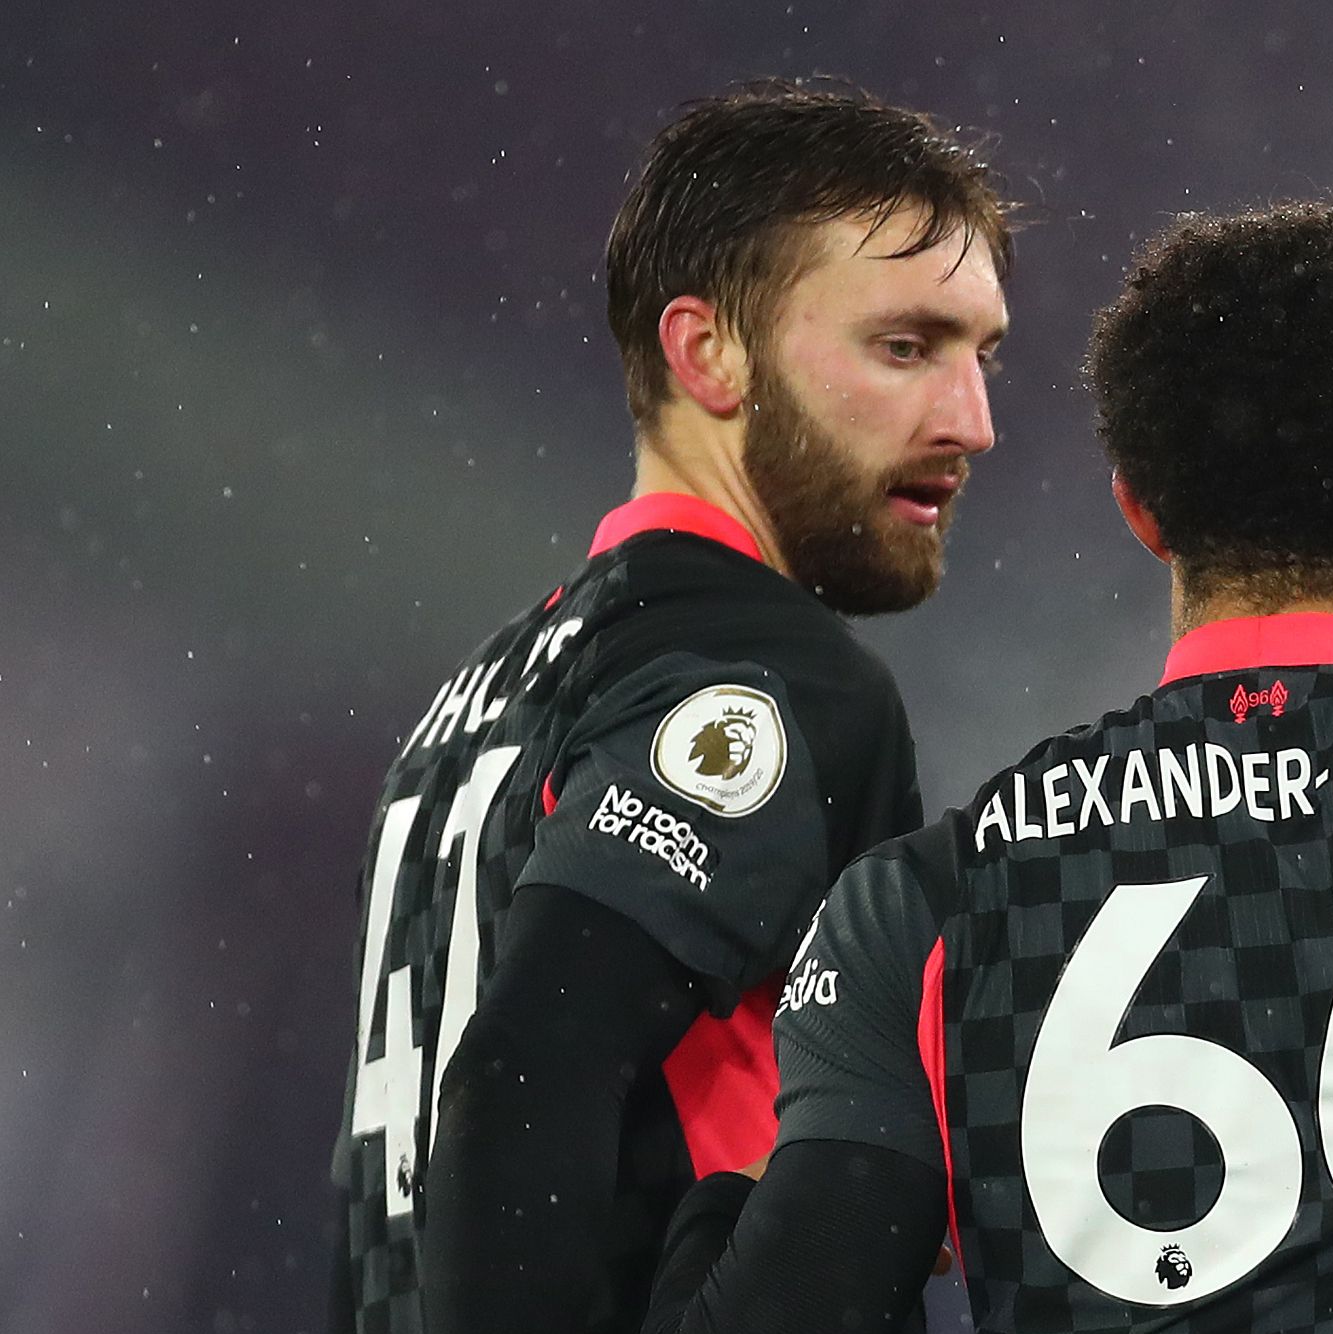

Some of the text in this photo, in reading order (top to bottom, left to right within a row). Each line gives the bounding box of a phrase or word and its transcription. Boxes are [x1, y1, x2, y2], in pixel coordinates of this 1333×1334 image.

[1248, 689, 1269, 708] 96
[588, 807, 708, 892] for racism
[599, 784, 709, 866] No room
